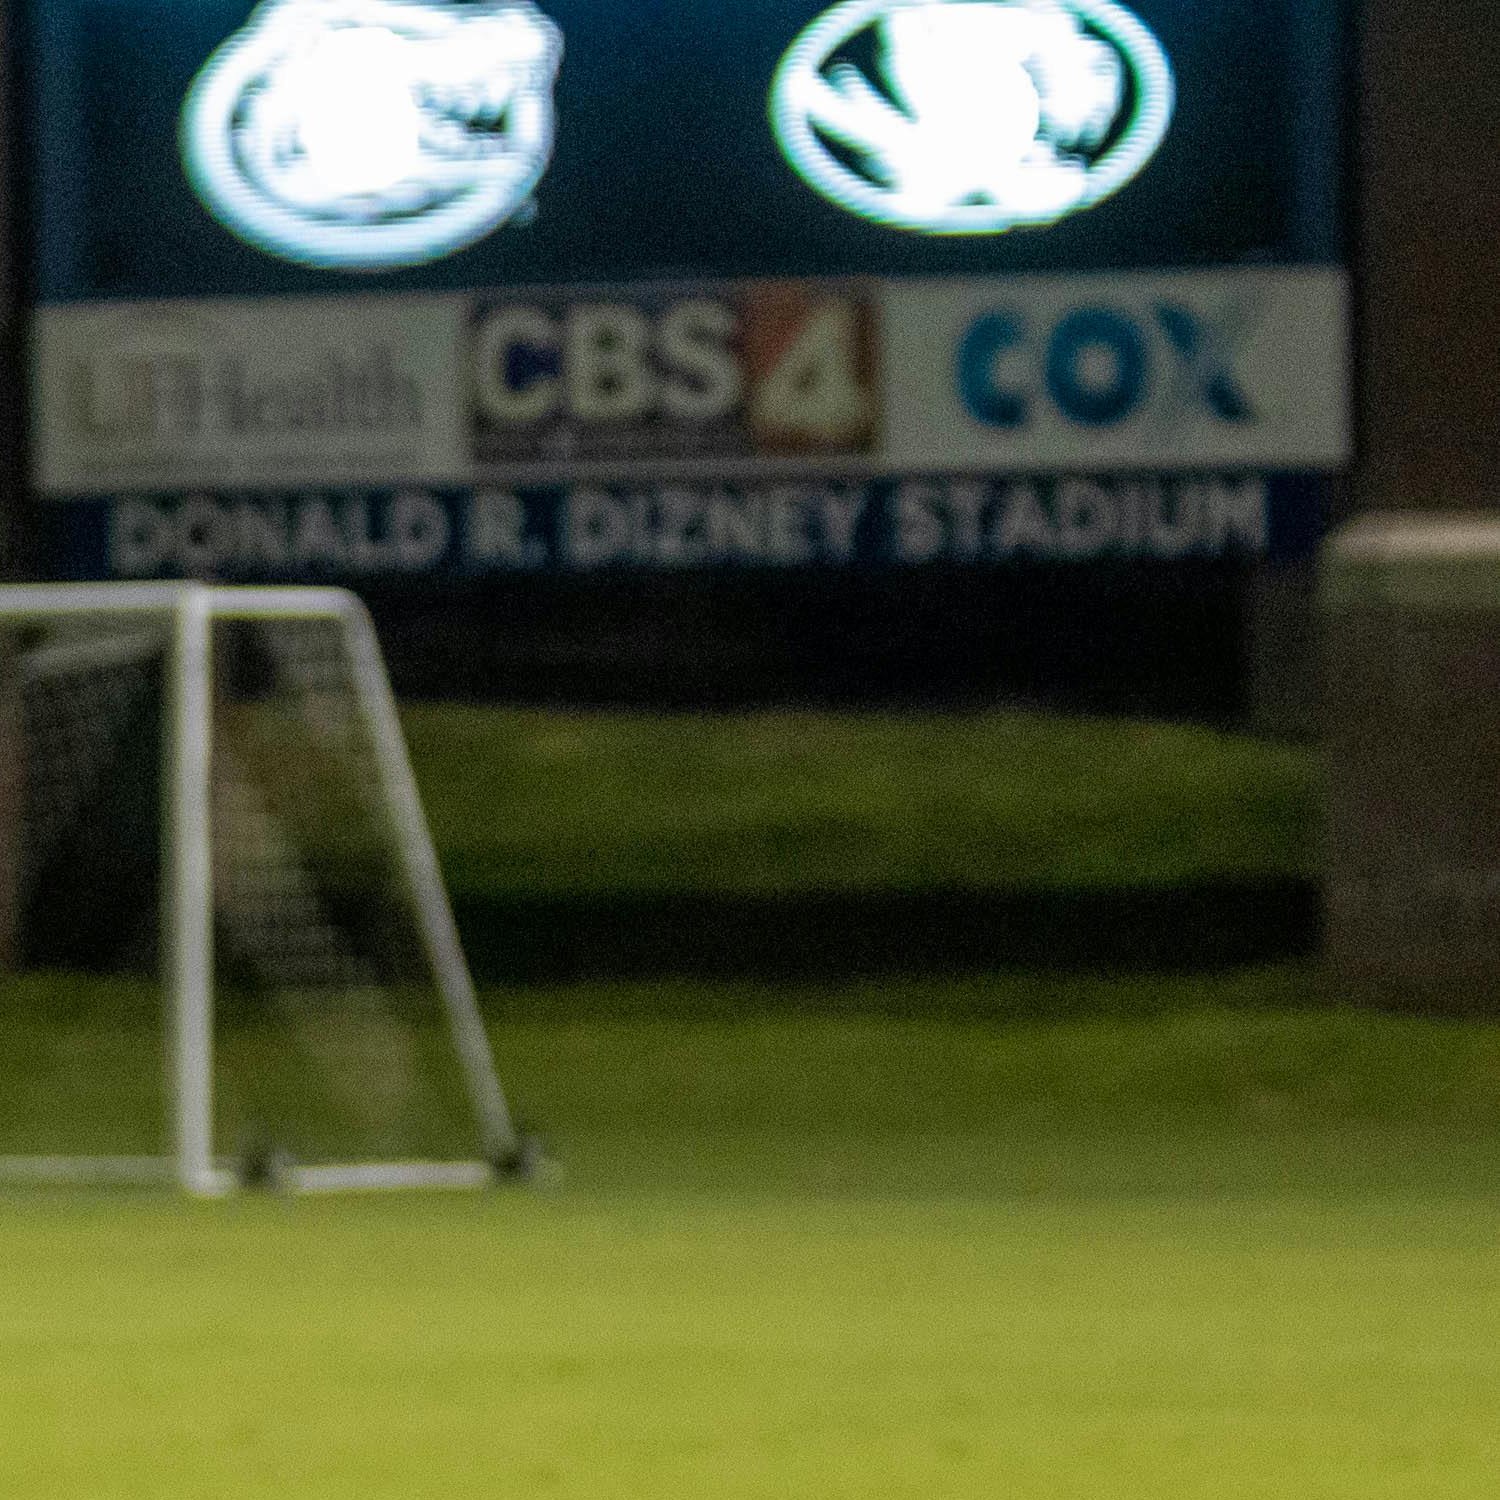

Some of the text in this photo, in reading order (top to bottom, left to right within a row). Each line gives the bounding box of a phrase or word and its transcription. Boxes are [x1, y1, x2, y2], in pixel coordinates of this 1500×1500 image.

[958, 298, 1268, 428] COX
[110, 480, 1266, 570] DONALD R. DIZNEY STADIUM
